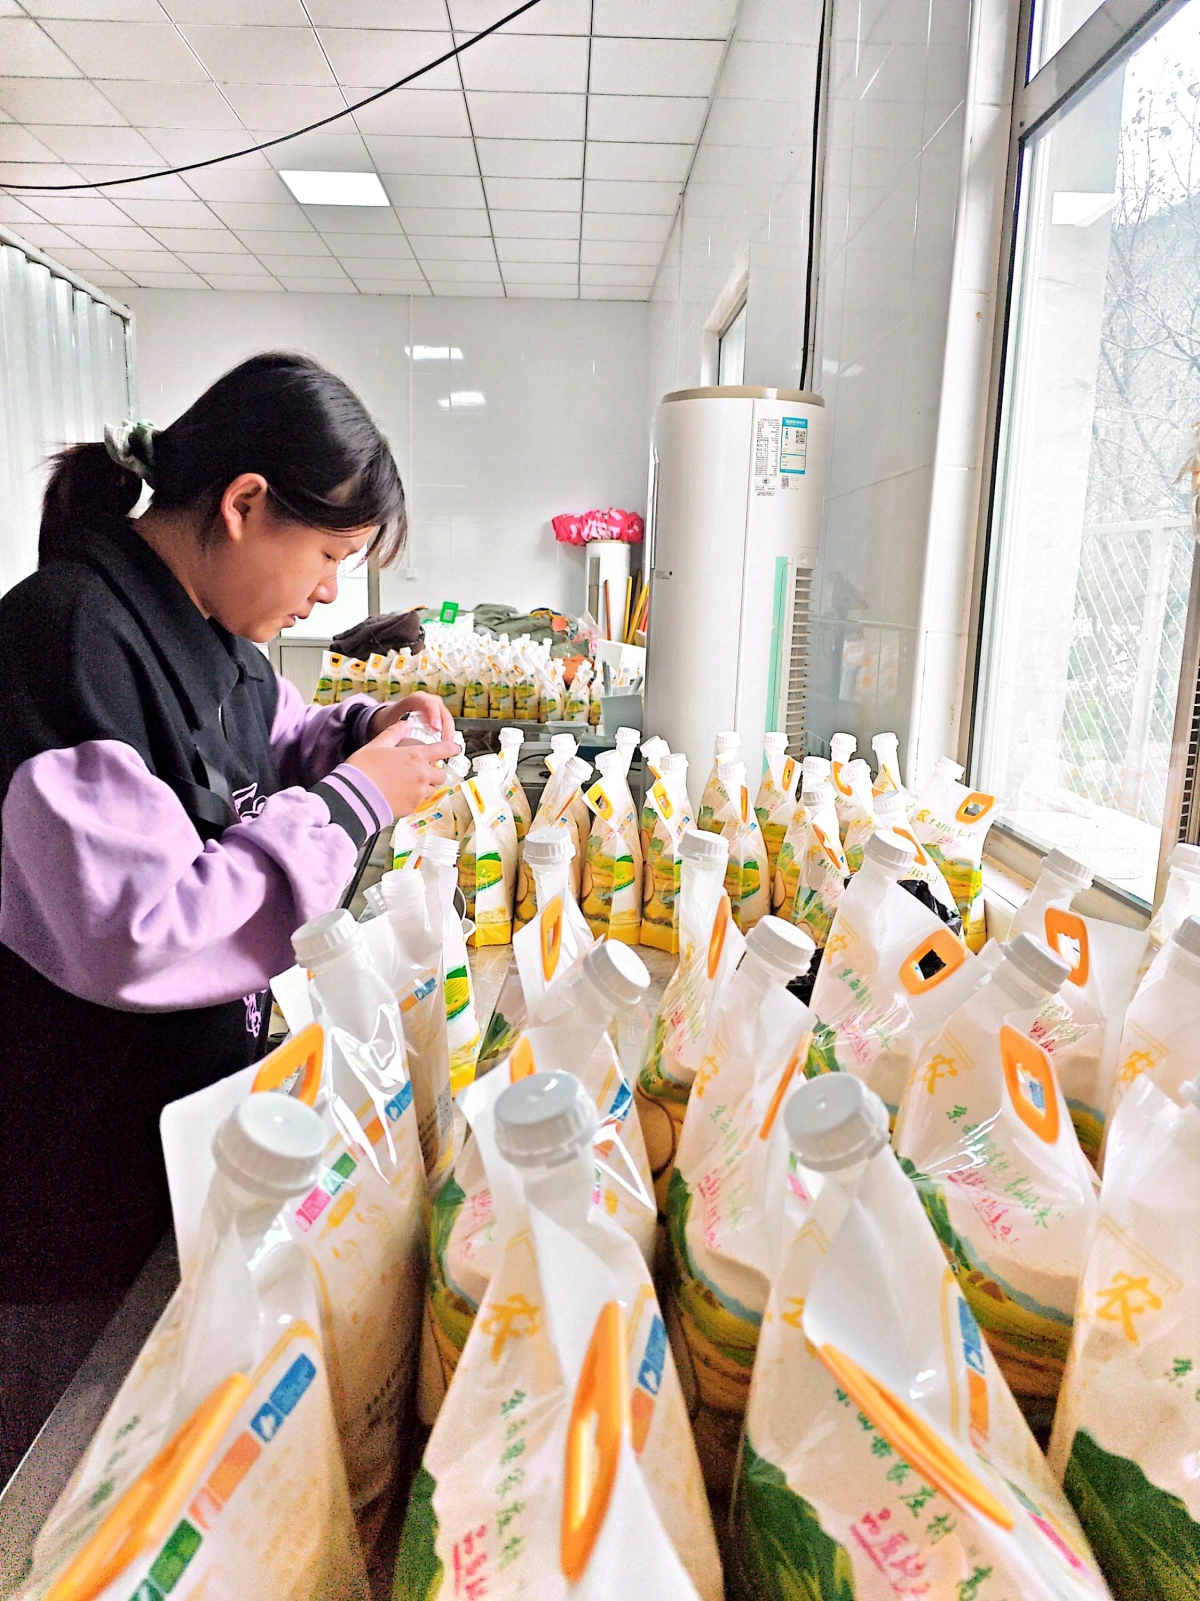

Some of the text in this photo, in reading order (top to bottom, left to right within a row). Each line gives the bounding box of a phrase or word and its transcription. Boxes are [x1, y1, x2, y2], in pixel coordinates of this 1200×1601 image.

[919, 1053, 958, 1096] 农
[479, 1293, 541, 1364] 农
[1096, 1269, 1163, 1347] 农
